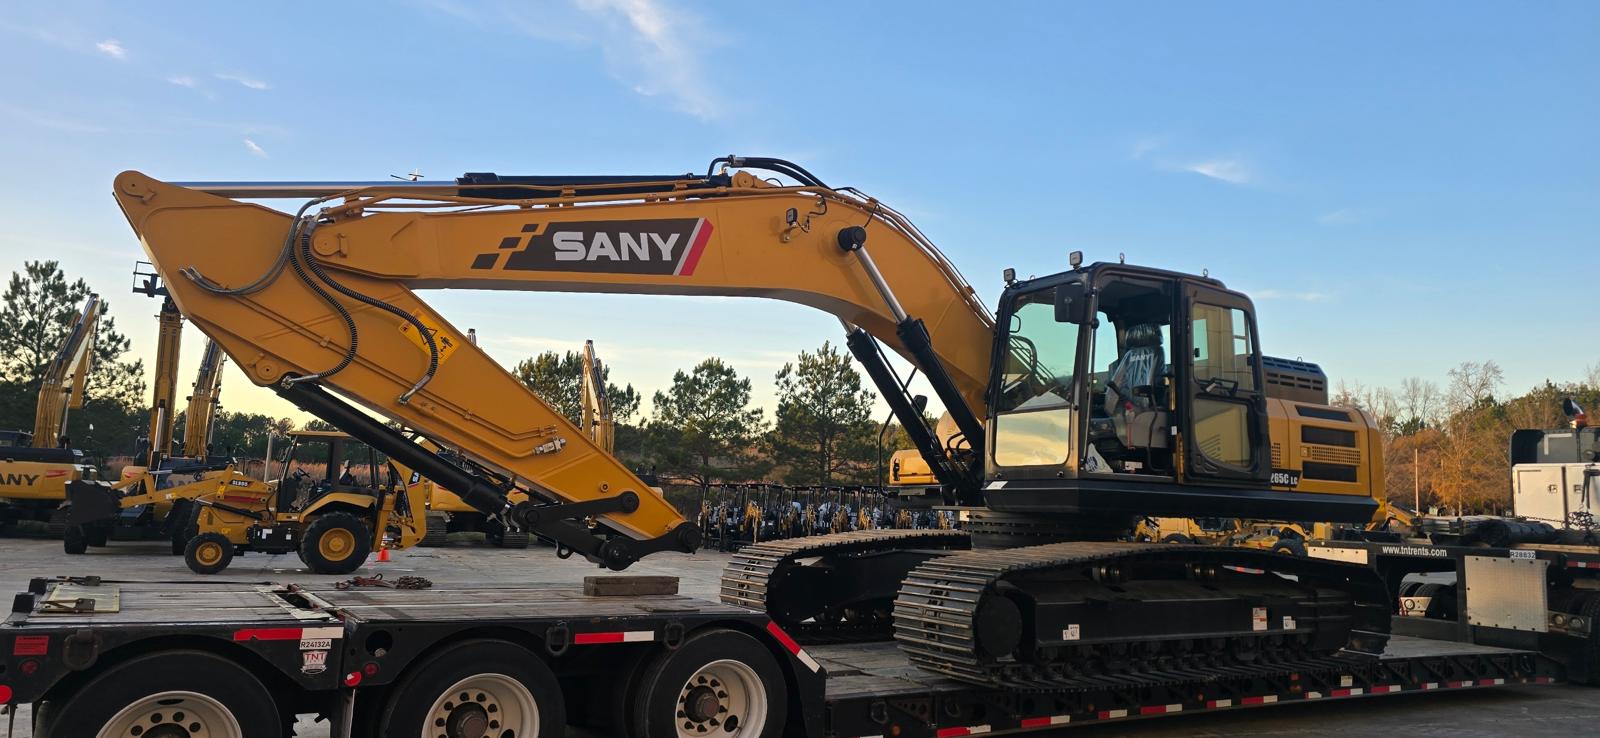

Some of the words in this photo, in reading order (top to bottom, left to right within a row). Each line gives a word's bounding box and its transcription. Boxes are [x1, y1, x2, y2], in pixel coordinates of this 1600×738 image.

[552, 231, 680, 261] SANY
[1290, 476, 1298, 485] LC
[1382, 546, 1447, 557] www.tntrents.com
[305, 652, 325, 660] TNT
